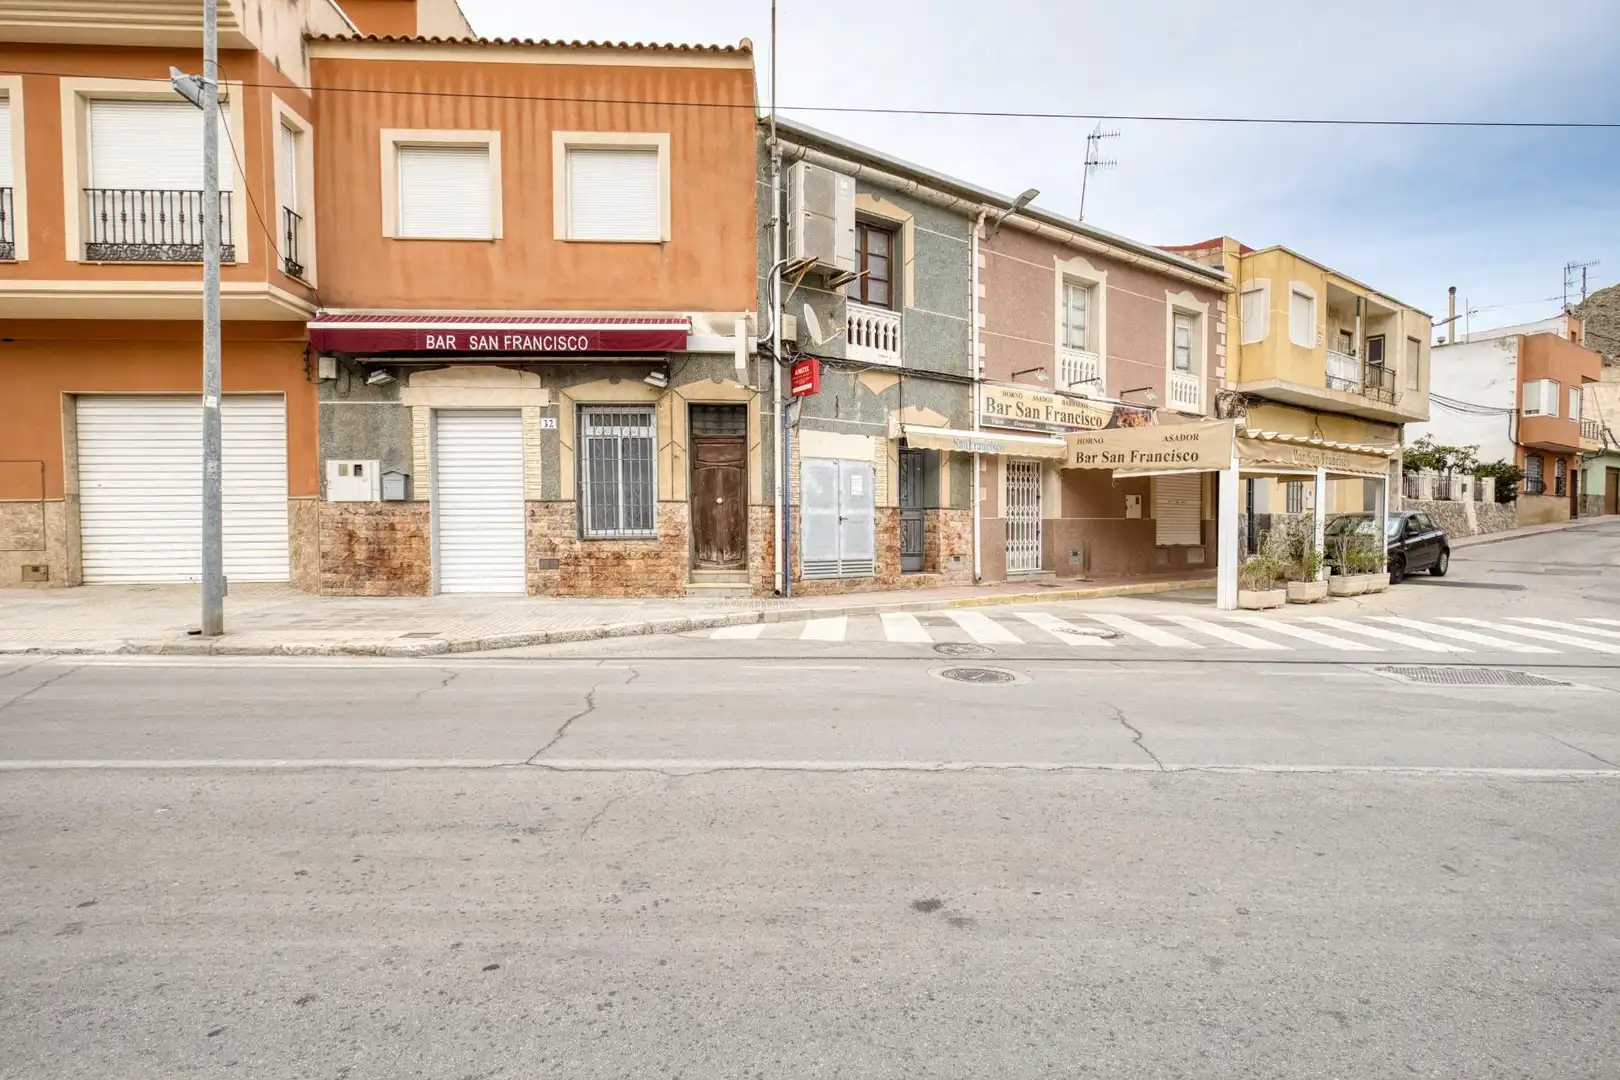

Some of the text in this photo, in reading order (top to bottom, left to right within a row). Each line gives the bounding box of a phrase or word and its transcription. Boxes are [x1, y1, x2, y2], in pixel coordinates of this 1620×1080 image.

[426, 335, 589, 350] BAR SAN FRANCISCO
[1002, 390, 1024, 399] HORNO
[986, 396, 1012, 416] Bar
[1015, 400, 1041, 420] San
[1045, 405, 1103, 428] Francisco
[544, 419, 554, 428] 32
[953, 438, 969, 450] San
[1076, 433, 1200, 445] HORNO ASADOR
[1076, 448, 1199, 464] Bar San Francisco
